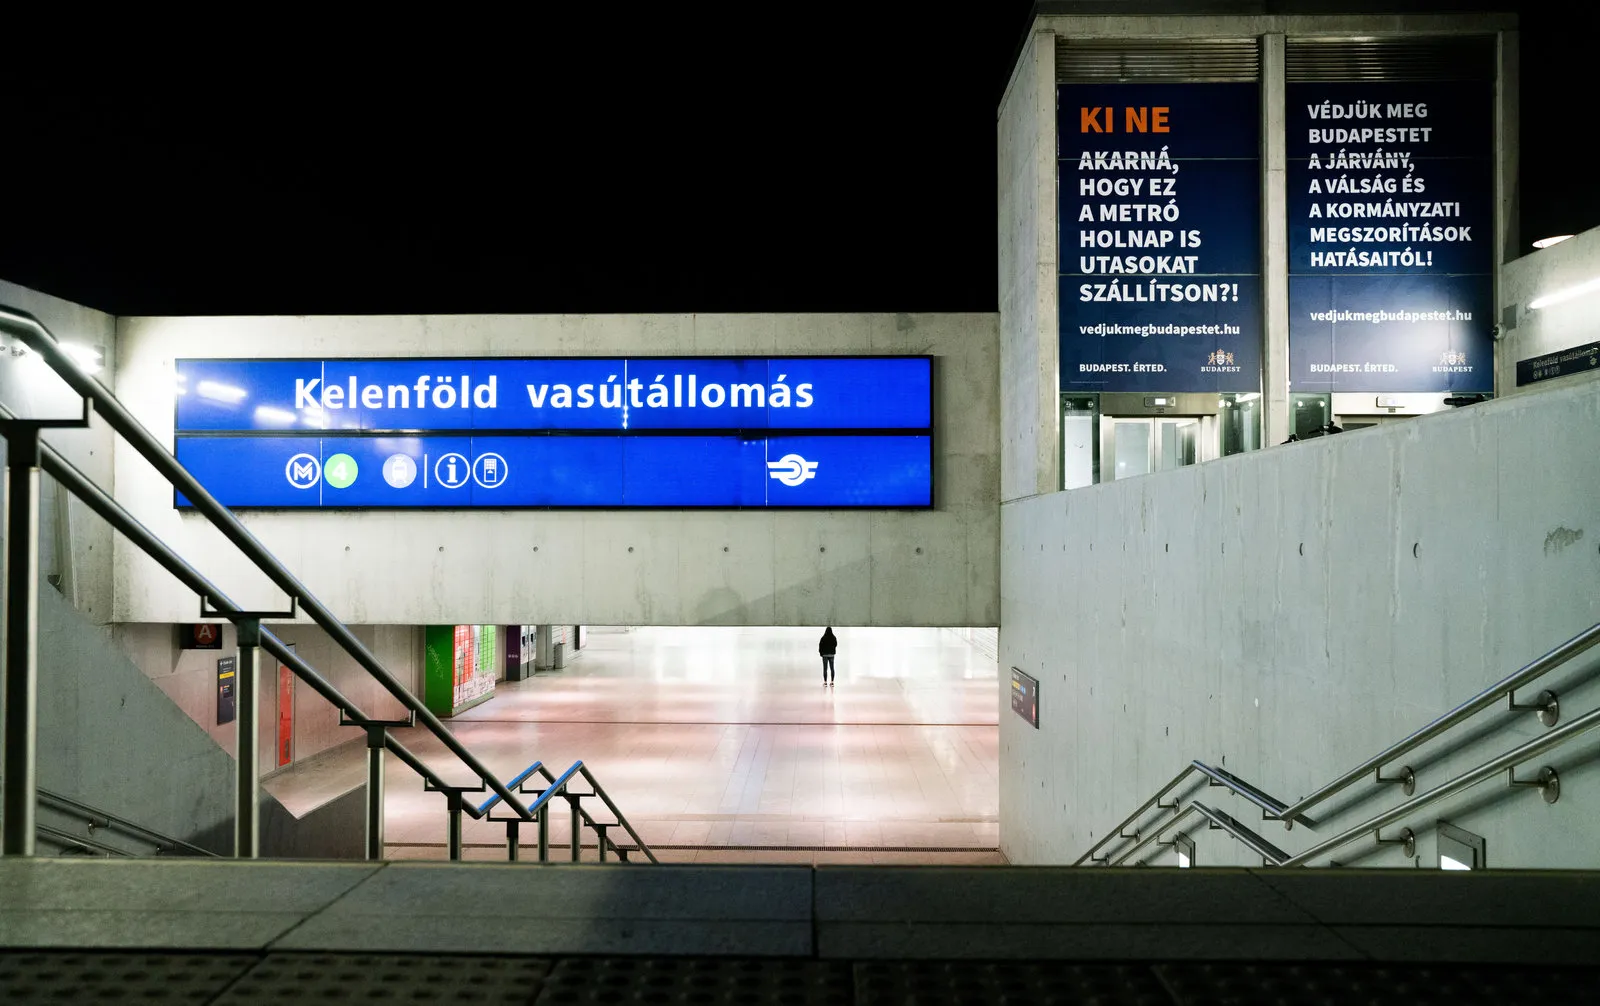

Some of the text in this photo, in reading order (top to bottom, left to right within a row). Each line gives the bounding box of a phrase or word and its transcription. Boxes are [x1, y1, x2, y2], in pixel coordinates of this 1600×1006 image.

[1307, 100, 1428, 119] VÉDJÜK MEG
[1080, 106, 1170, 134] KI NE
[1308, 127, 1433, 144] BUDAPESTET
[1078, 145, 1180, 174] AKARNÁ,
[1308, 148, 1415, 172] A JÁRVÁNY,
[1079, 178, 1177, 196] HOGY EZ
[1308, 173, 1426, 194] A VÁLSÁG ÉS
[1078, 198, 1180, 222] A METRÓ
[1308, 197, 1460, 218] A KORMÁNYZATI
[1080, 229, 1202, 248] HOLNAP IS
[1310, 222, 1472, 243] MEGSZORÍTÁSOK
[1080, 255, 1199, 274] UTASOKAT
[1310, 247, 1433, 267] HATÁSAITÓL!
[1079, 278, 1239, 302] SZÁLLÍTSON?!
[1310, 309, 1473, 324] vedjukmegbudapestet.hu
[1079, 323, 1240, 337] vedjukmegbudapestet.hu
[1079, 361, 1168, 373] BUDAPEST. ÉRTED.
[1310, 361, 1399, 373] BUDAPEST. ÉRTED.
[294, 374, 814, 409] Kelenföld vasútállomás
[332, 461, 349, 481] 4
[198, 624, 212, 639] A
